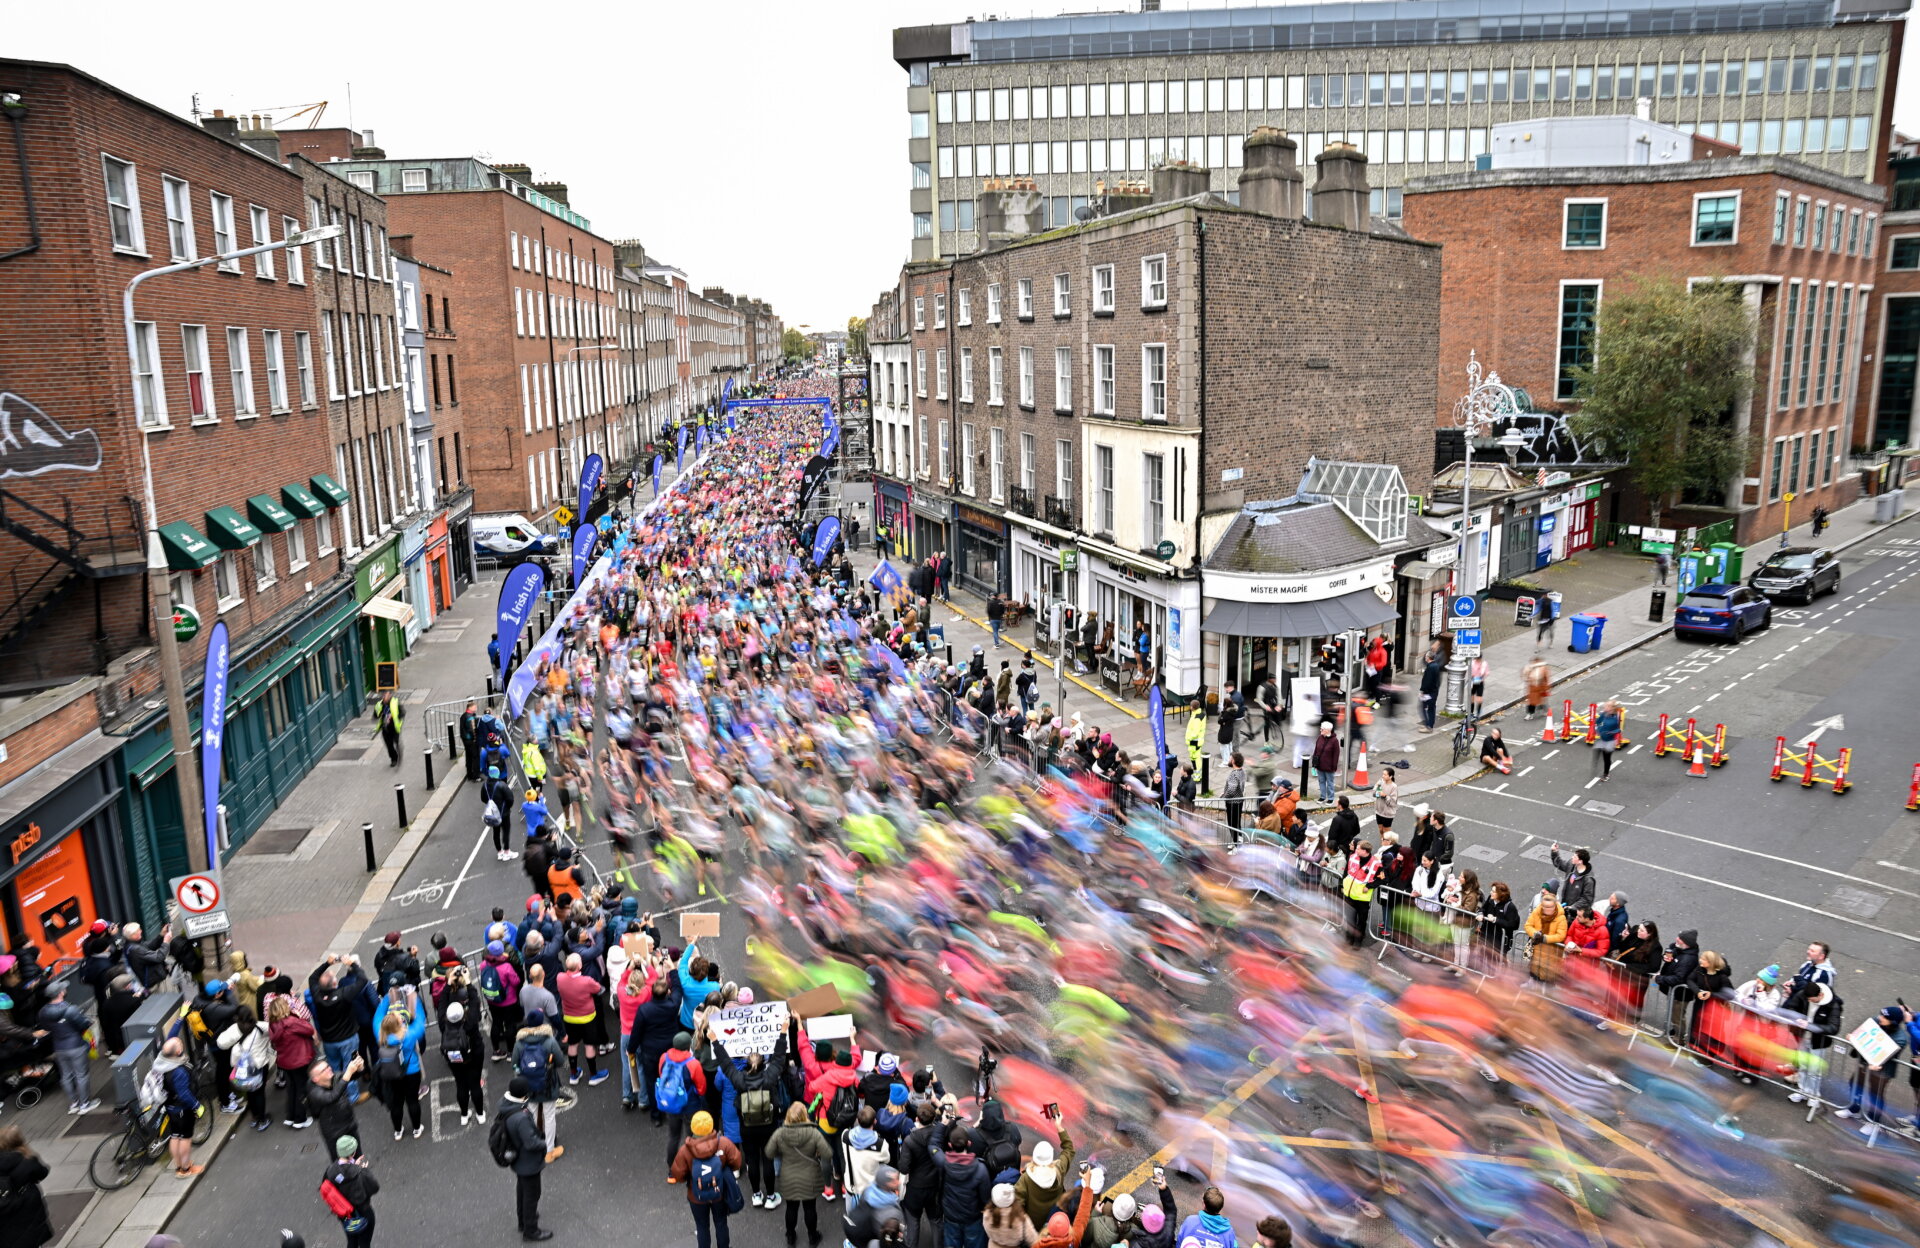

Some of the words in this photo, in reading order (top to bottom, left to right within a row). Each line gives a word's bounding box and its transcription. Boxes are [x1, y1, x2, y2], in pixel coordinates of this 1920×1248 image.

[588, 472, 596, 485] Irish
[592, 460, 601, 474] Life
[580, 541, 590, 556] Irish
[586, 531, 595, 544] Life
[821, 534, 831, 549] Irish
[828, 524, 838, 539] Life
[511, 589, 528, 615] Irish
[523, 573, 539, 593] Life
[1329, 578, 1347, 589] COFFEE
[1103, 667, 1118, 682] Coca-Cola
[10, 821, 41, 865] ptsb
[721, 1008, 753, 1020] LEGS
[761, 1004, 776, 1013] OF
[737, 1026, 748, 1035] OF
[752, 1023, 782, 1035] GOLD
